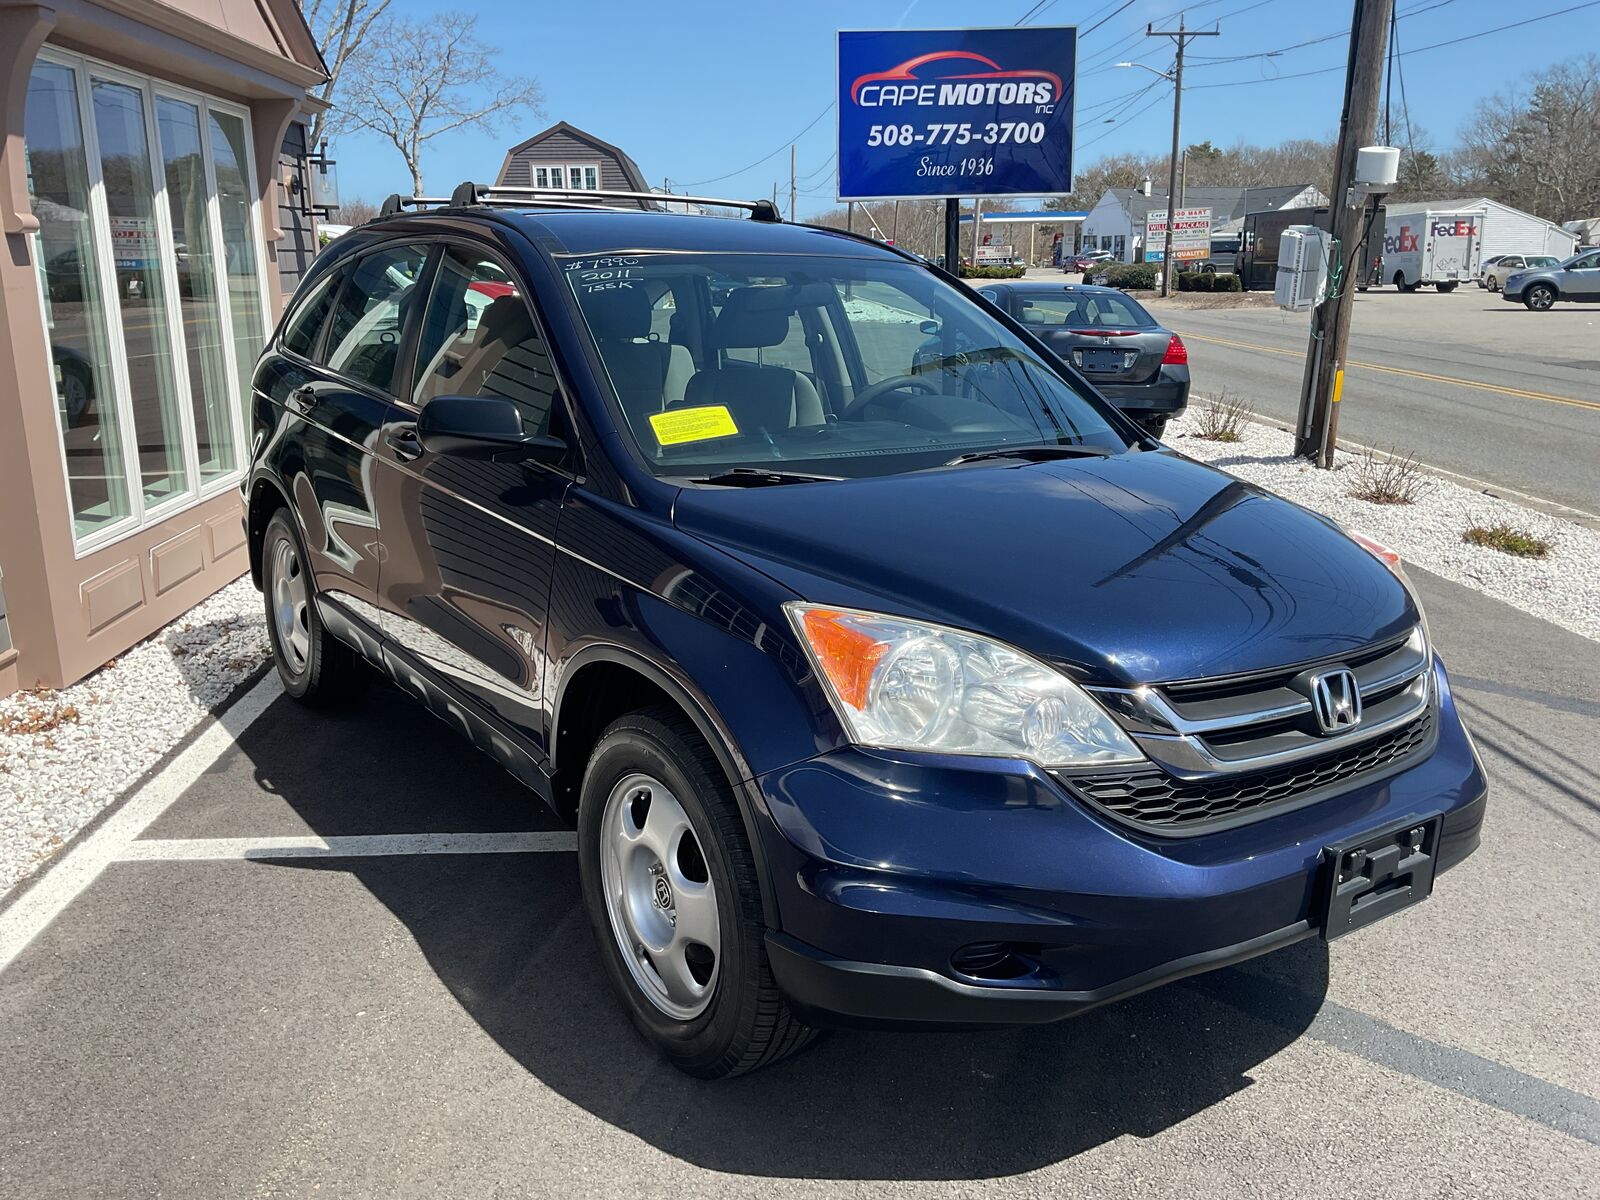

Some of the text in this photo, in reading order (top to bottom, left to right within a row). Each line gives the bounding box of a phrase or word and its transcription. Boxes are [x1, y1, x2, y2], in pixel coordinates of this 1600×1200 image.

[860, 82, 1053, 107] CAPE MOTORS
[867, 121, 1045, 147] 508-775-3700
[916, 155, 994, 177] Since 1936
[1384, 226, 1419, 254] edEx
[1430, 220, 1477, 237] FedEx
[581, 270, 630, 280] 2011
